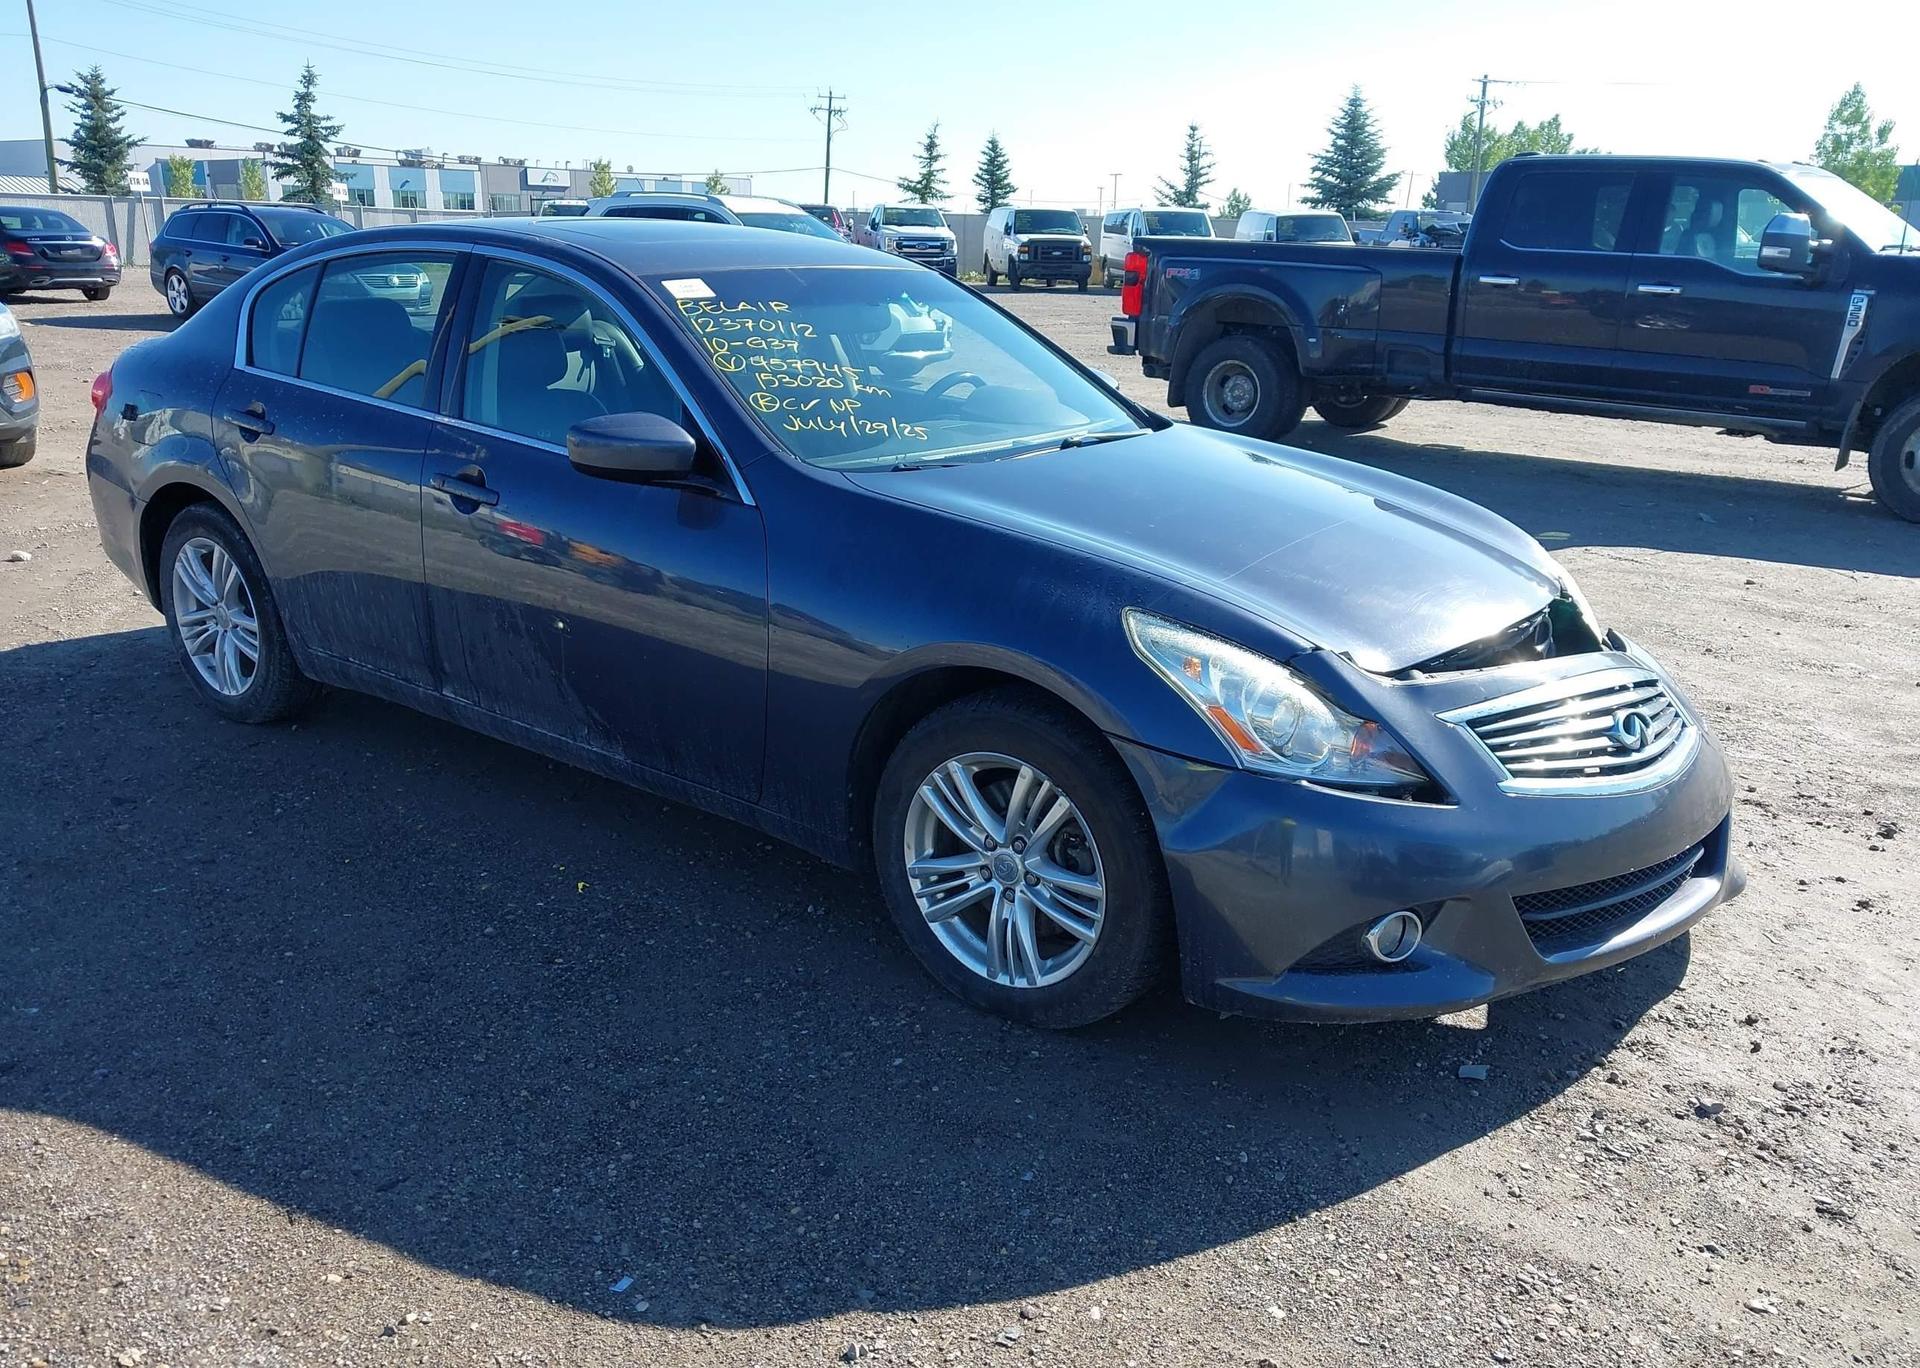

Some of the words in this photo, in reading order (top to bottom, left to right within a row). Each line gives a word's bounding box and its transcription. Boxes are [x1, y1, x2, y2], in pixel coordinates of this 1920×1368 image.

[676, 300, 792, 318] BELAIR
[1847, 296, 1864, 327] F350
[691, 317, 817, 338] 12370112
[703, 337, 799, 353] 10-G37
[750, 355, 864, 381] 457945
[756, 372, 844, 389] 153020
[830, 398, 861, 414] NP
